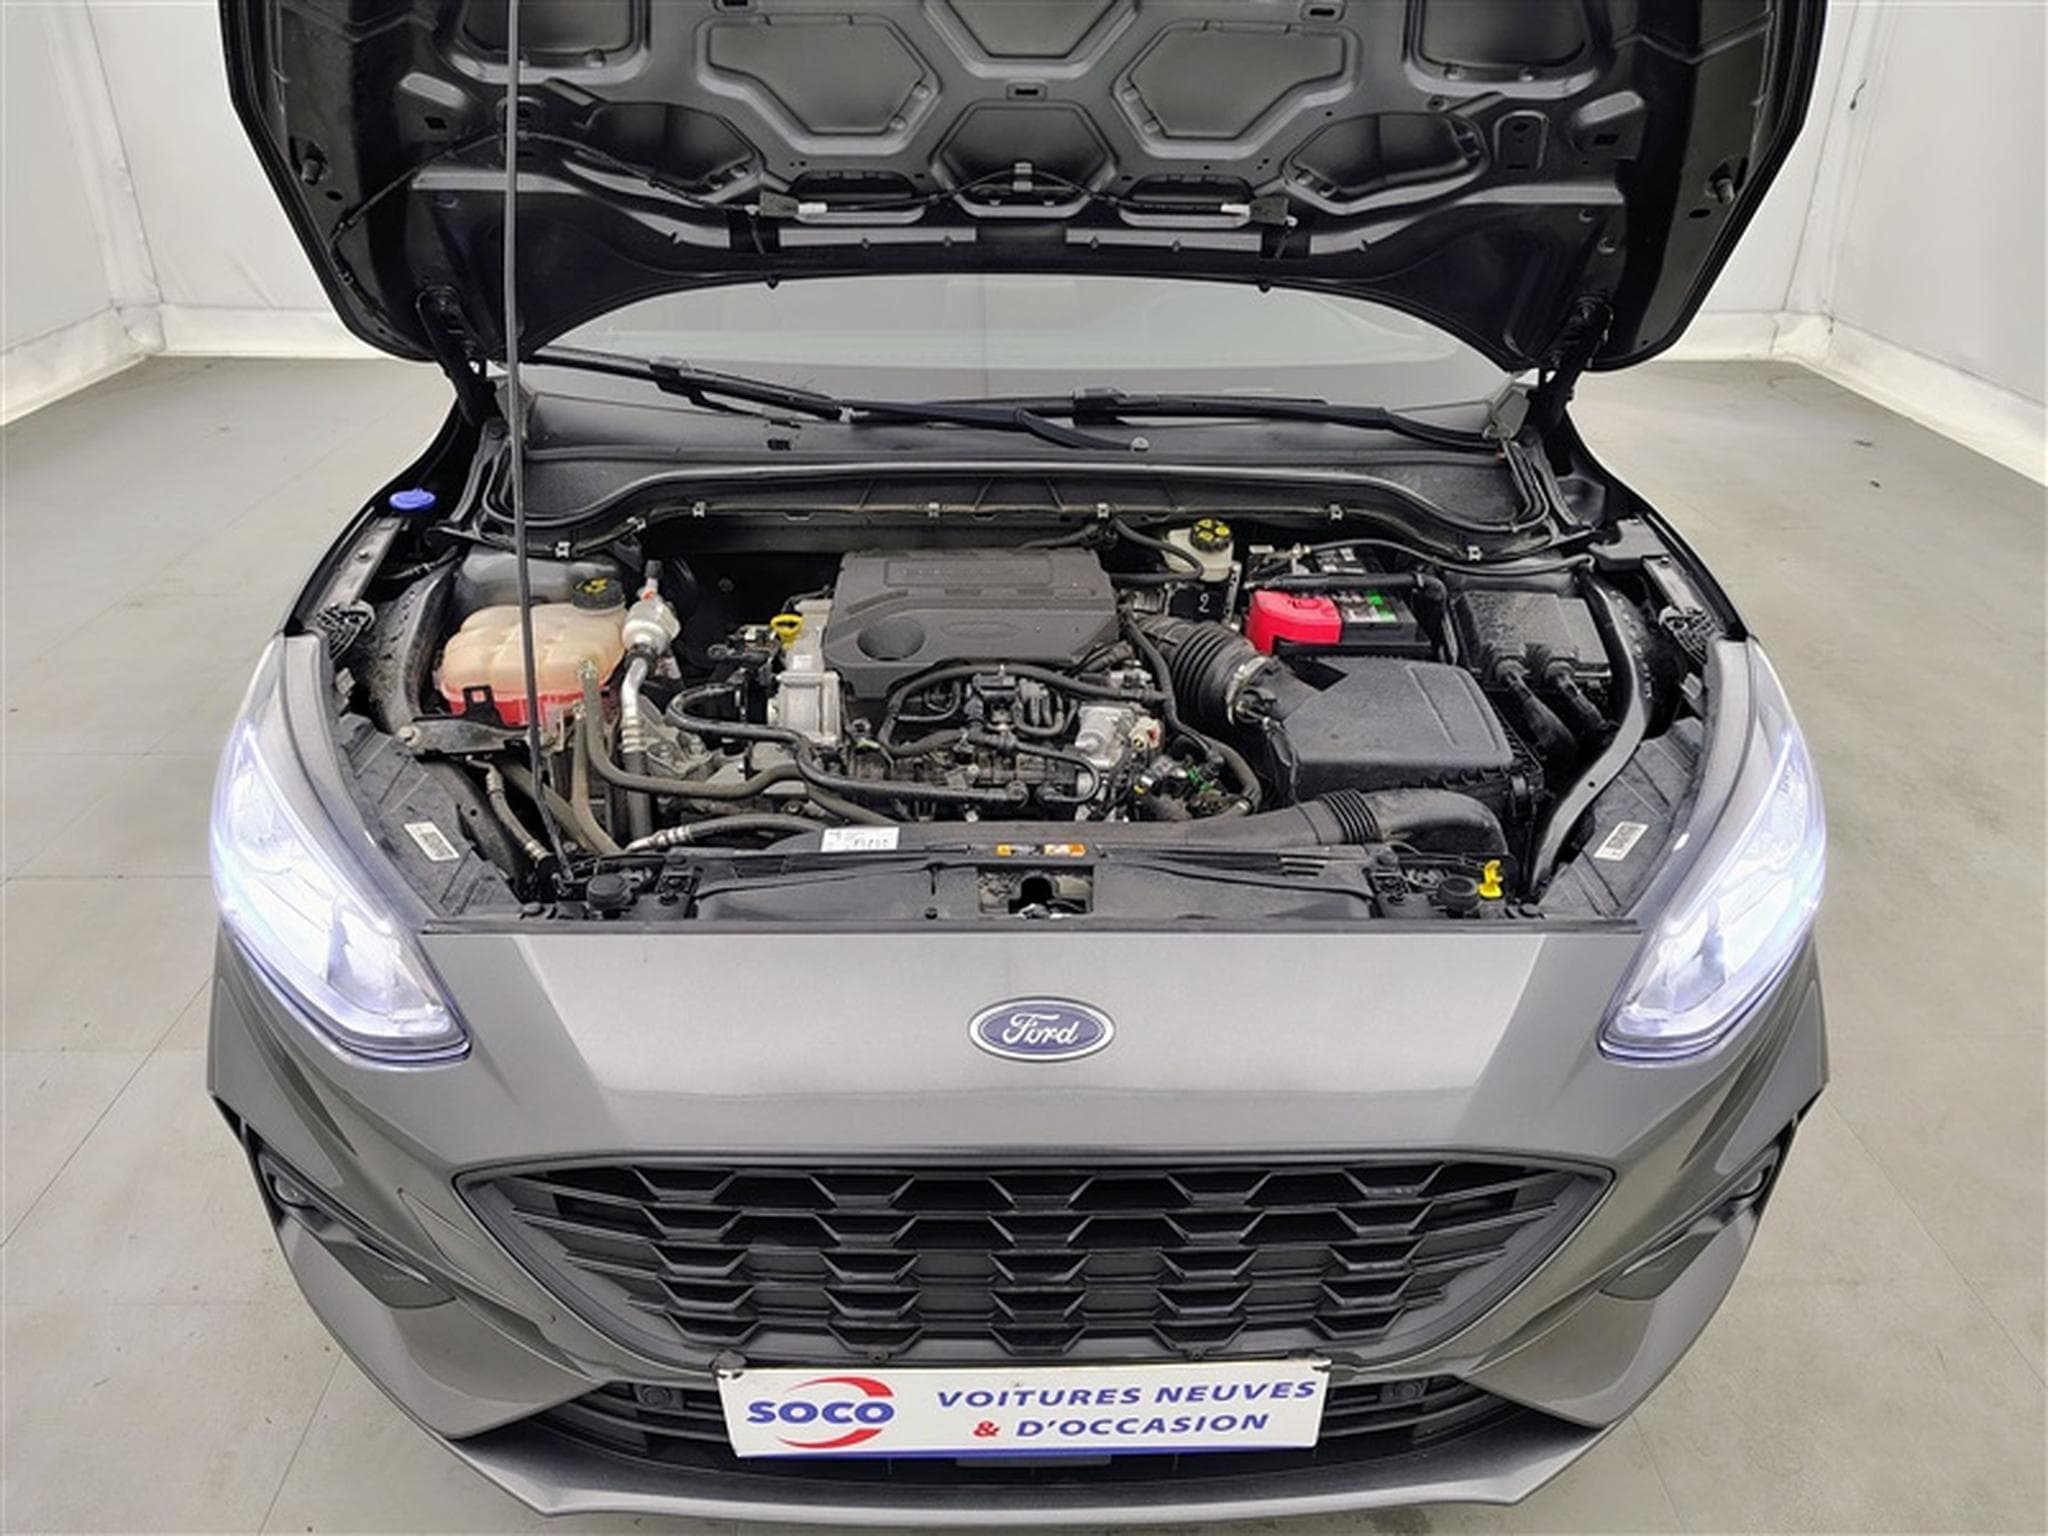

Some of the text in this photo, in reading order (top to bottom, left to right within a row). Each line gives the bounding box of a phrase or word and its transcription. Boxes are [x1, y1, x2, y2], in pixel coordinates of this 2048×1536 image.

[1198, 592, 1210, 614] 2
[1002, 1012, 1080, 1045] Ford
[937, 1381, 1317, 1408] VOITURES NEUVES
[746, 1400, 895, 1424] SOCO
[972, 1414, 1269, 1438] & D'OCCASION
